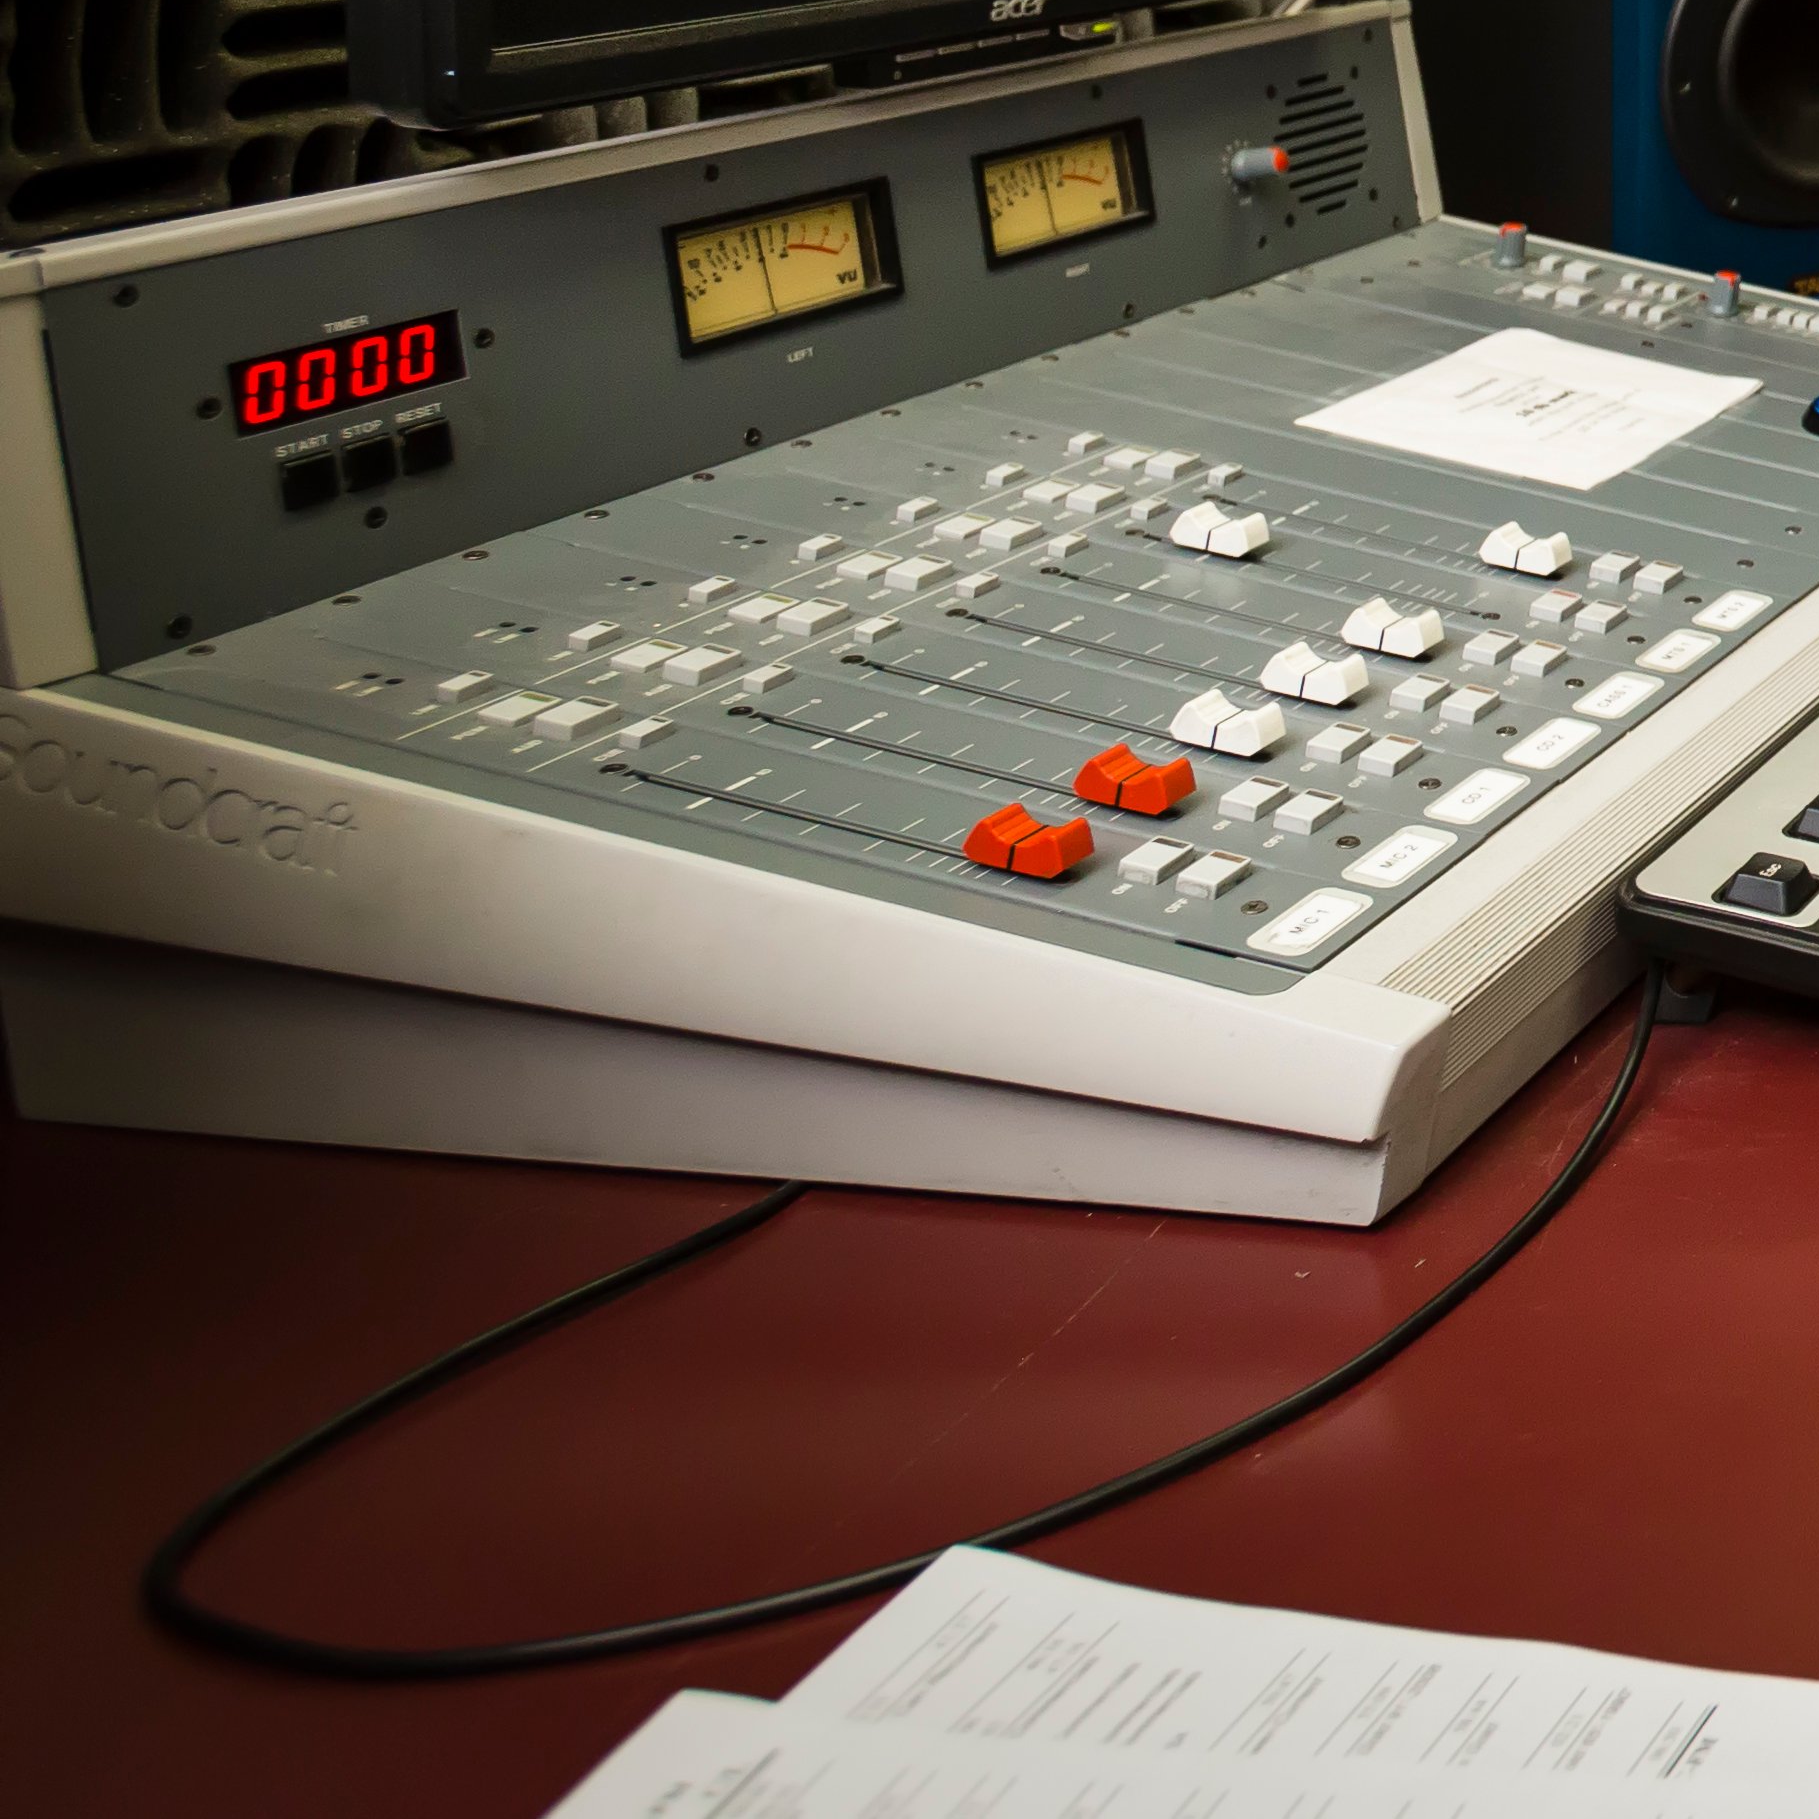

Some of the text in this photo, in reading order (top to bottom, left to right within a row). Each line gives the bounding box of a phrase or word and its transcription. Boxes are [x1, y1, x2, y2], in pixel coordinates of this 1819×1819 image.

[836, 268, 859, 285] VU
[322, 314, 370, 334] TIMER
[786, 345, 814, 364] LEFT
[244, 324, 436, 424] 0000
[394, 402, 443, 424] RESET
[341, 419, 384, 440] STOP
[275, 433, 330, 458] START
[1262, 833, 1285, 848] OFF
[1380, 850, 1408, 870] MIC
[1759, 861, 1783, 878] Esc
[1111, 883, 1134, 896] ON
[1164, 896, 1189, 915] OFF
[1289, 914, 1319, 936] MIC
